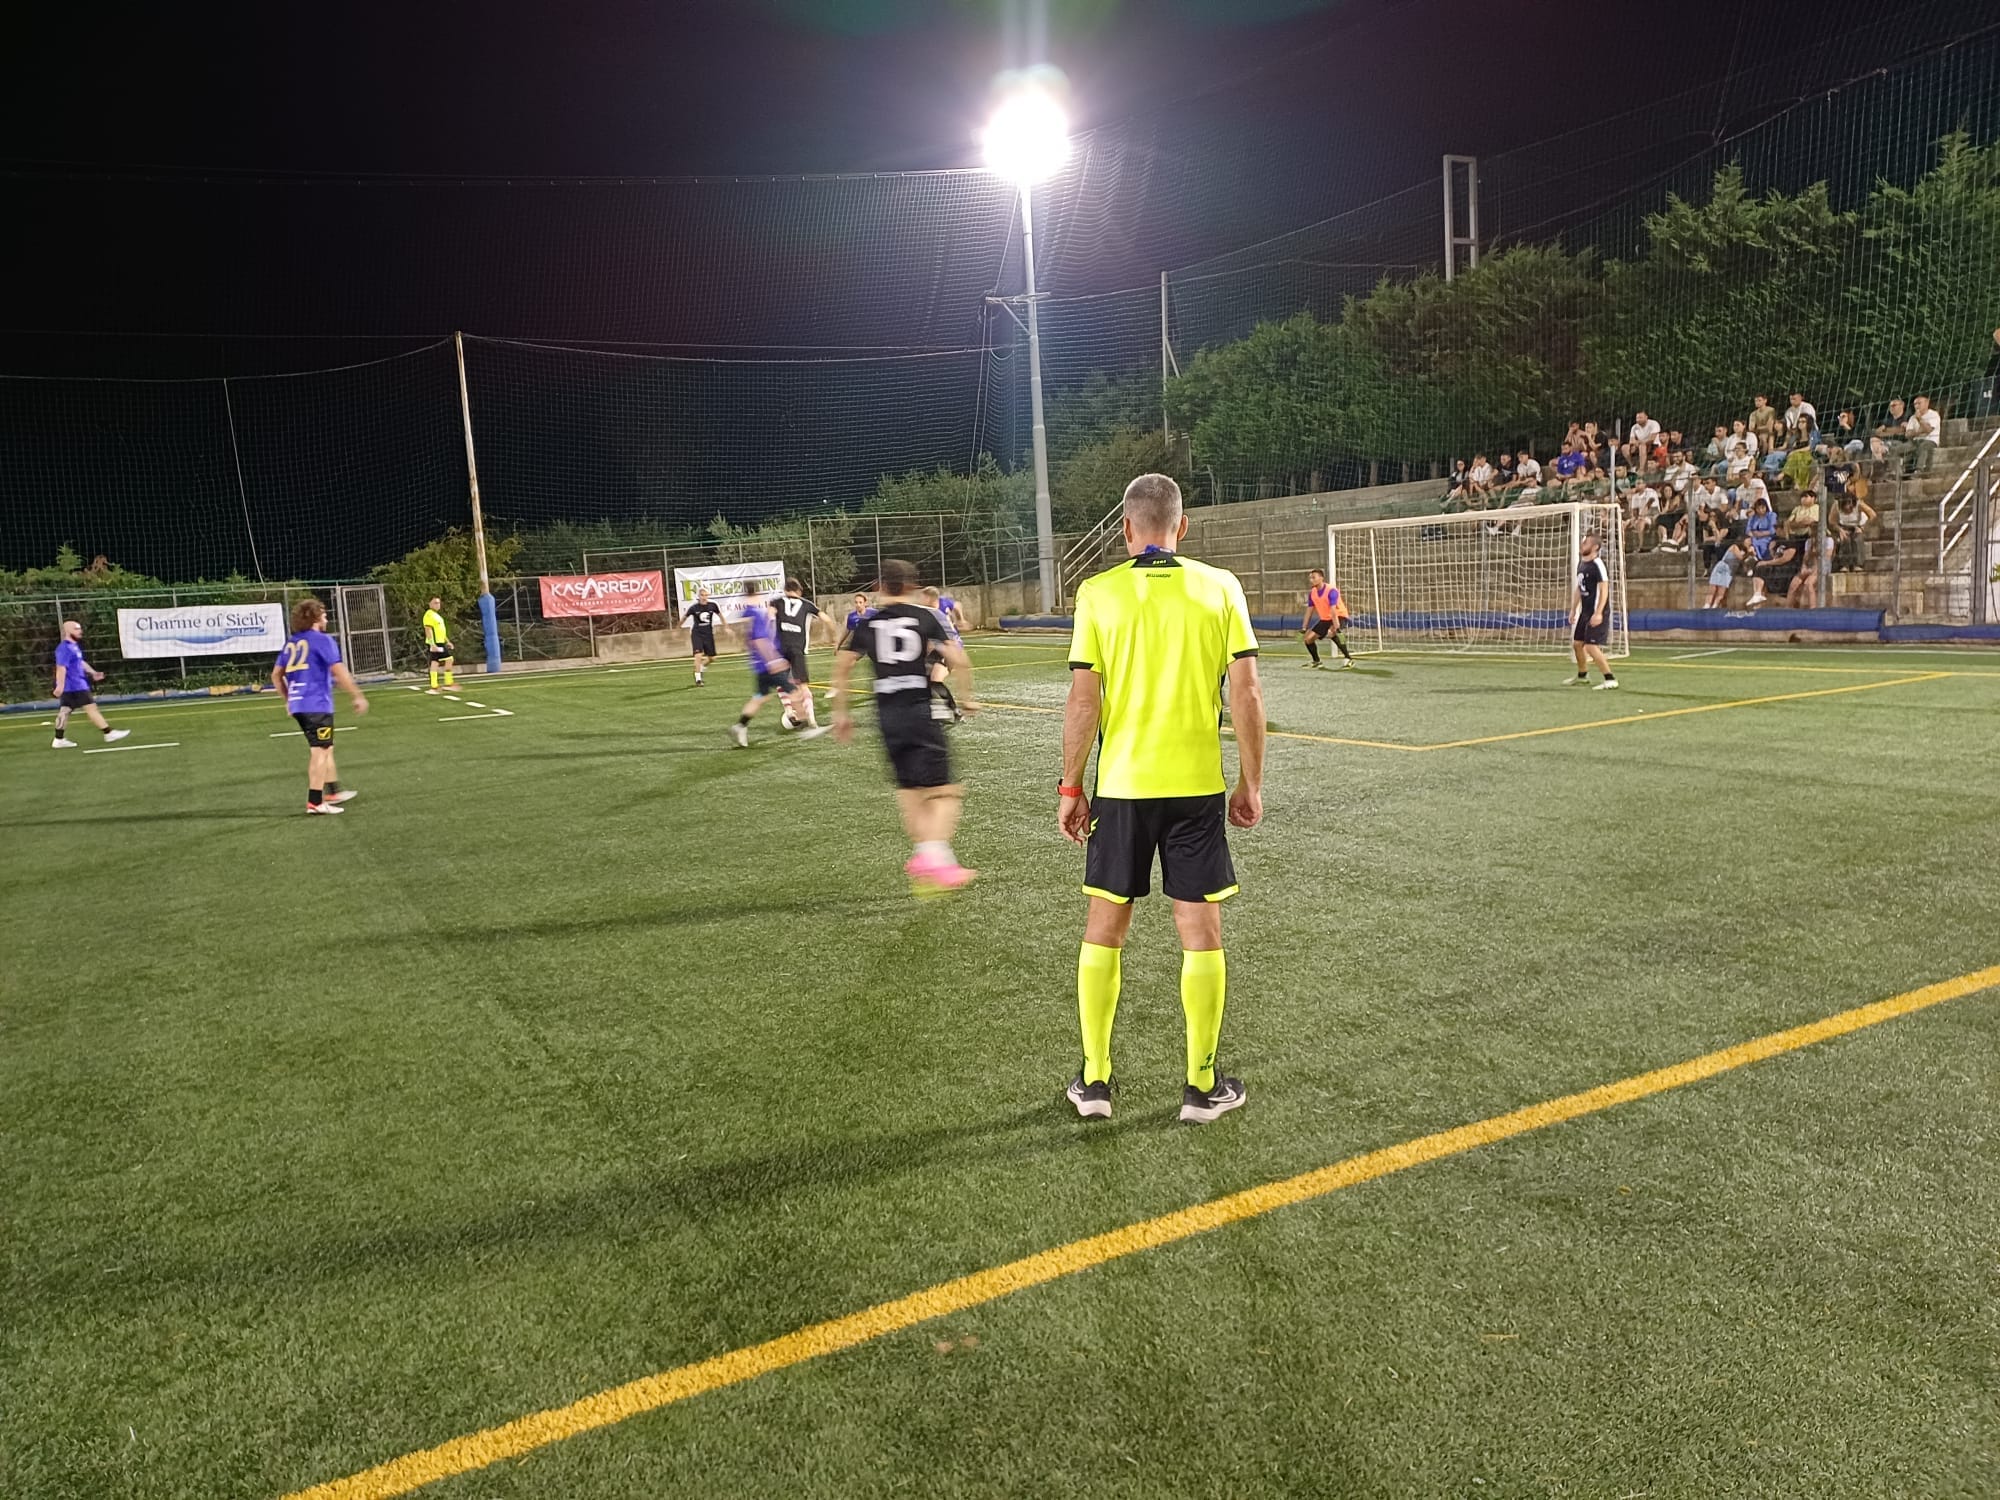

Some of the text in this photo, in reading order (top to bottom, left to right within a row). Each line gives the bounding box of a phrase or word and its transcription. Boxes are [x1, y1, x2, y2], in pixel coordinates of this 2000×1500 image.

[551, 577, 654, 599] KASARREDA
[782, 597, 803, 617] 17
[136, 611, 268, 631] Charme of Sicily
[284, 639, 309, 673] 22
